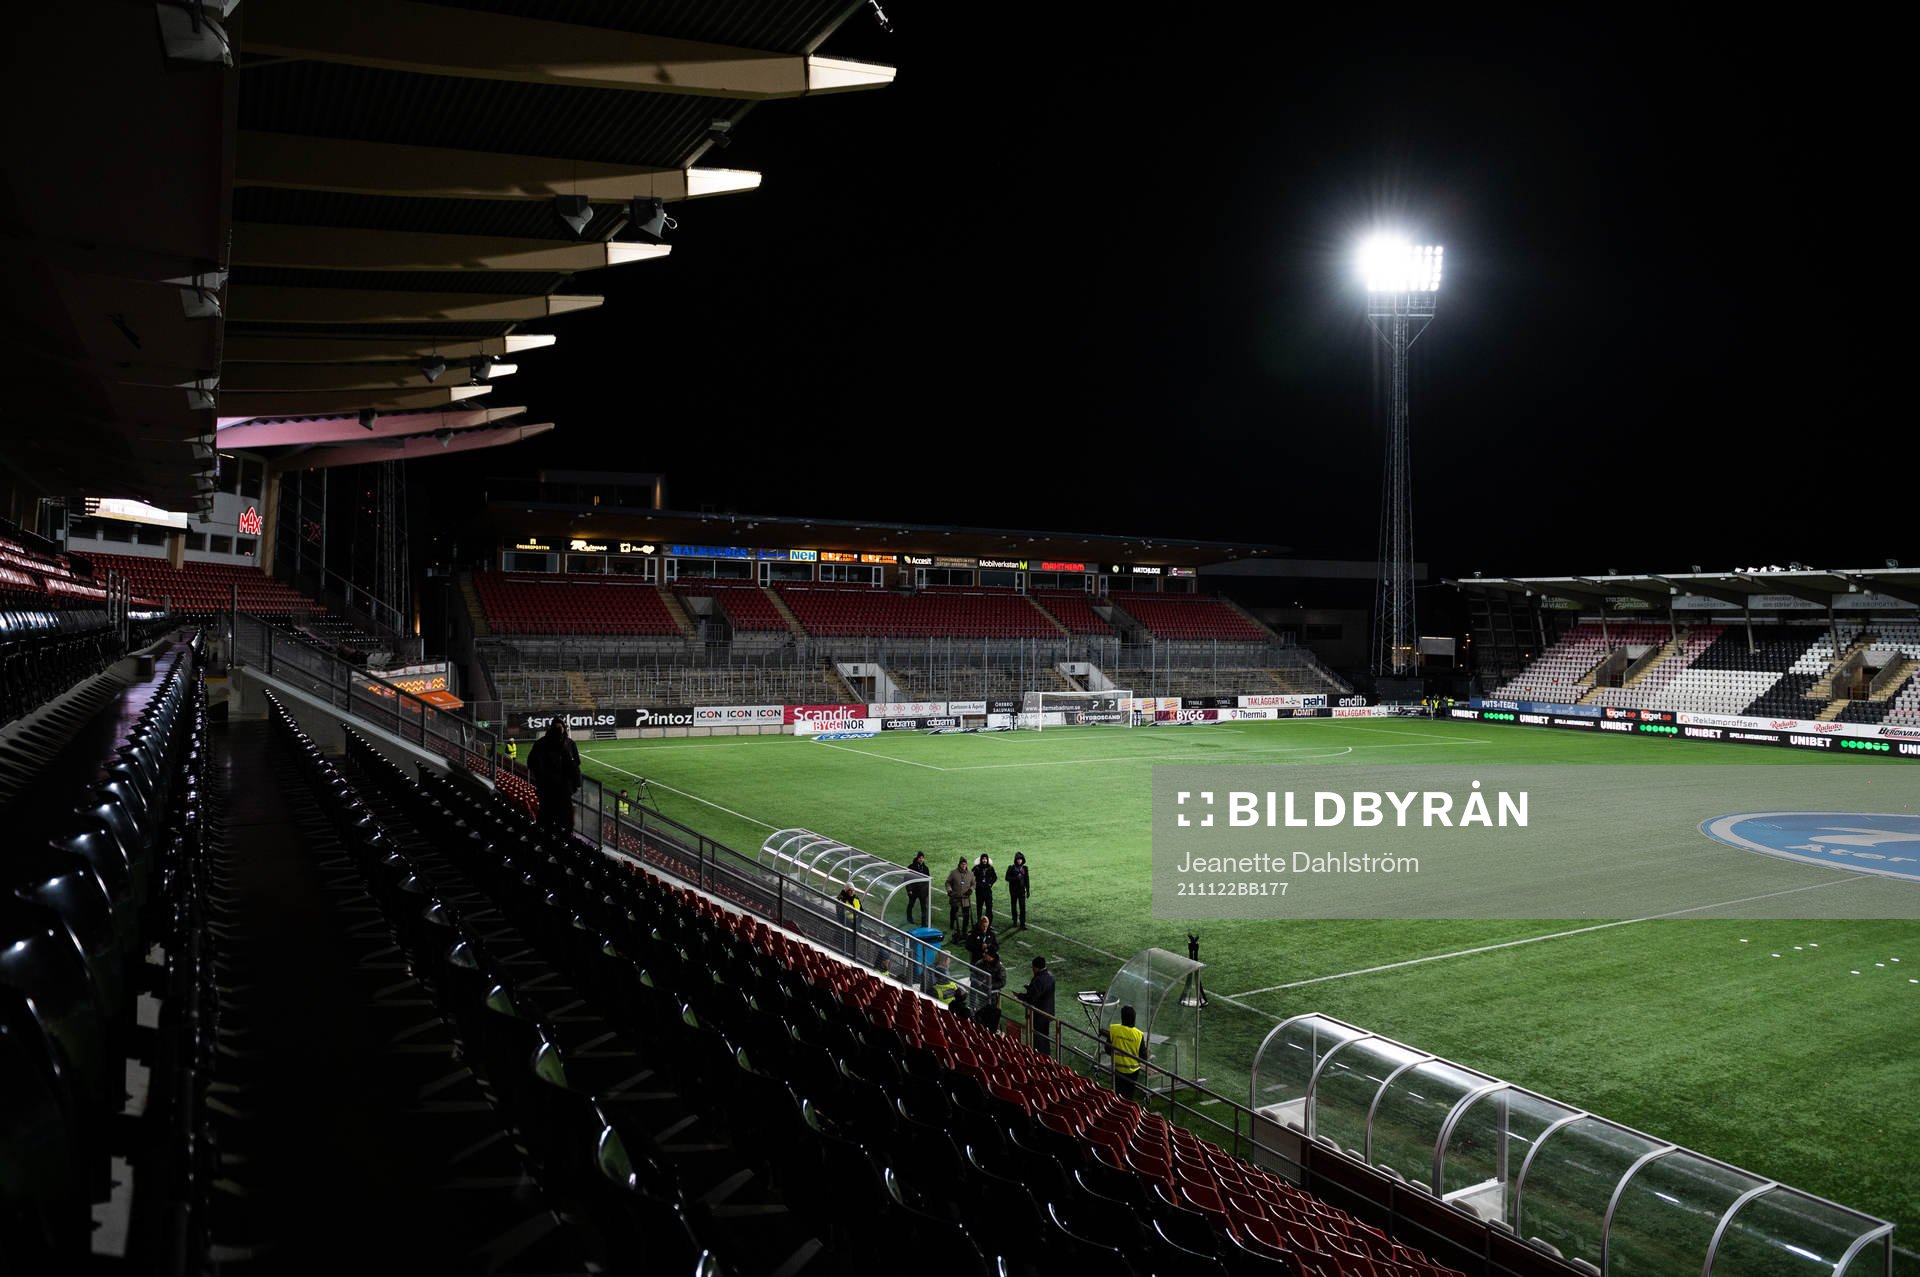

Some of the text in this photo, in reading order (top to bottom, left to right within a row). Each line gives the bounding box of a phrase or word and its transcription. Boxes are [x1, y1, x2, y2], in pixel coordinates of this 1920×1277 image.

[239, 506, 262, 535] MAX
[979, 560, 1019, 568] Mobilverkstan
[1303, 695, 1325, 707] pahl
[636, 709, 693, 726] Printoz
[697, 710, 722, 718] ICON
[727, 710, 752, 718] ICON
[757, 709, 781, 717] ICON
[794, 706, 856, 720] Scandic
[1239, 710, 1267, 718] Thermia
[1451, 709, 1479, 718] UNIBET
[528, 713, 615, 728] tsrlam.se
[1520, 715, 1549, 725] UNIBET
[1692, 717, 1759, 728] Reklamproffsen
[1600, 721, 1633, 731] UNIBET
[1685, 727, 1722, 738] UNIBET
[1790, 735, 1832, 747] UNIBET
